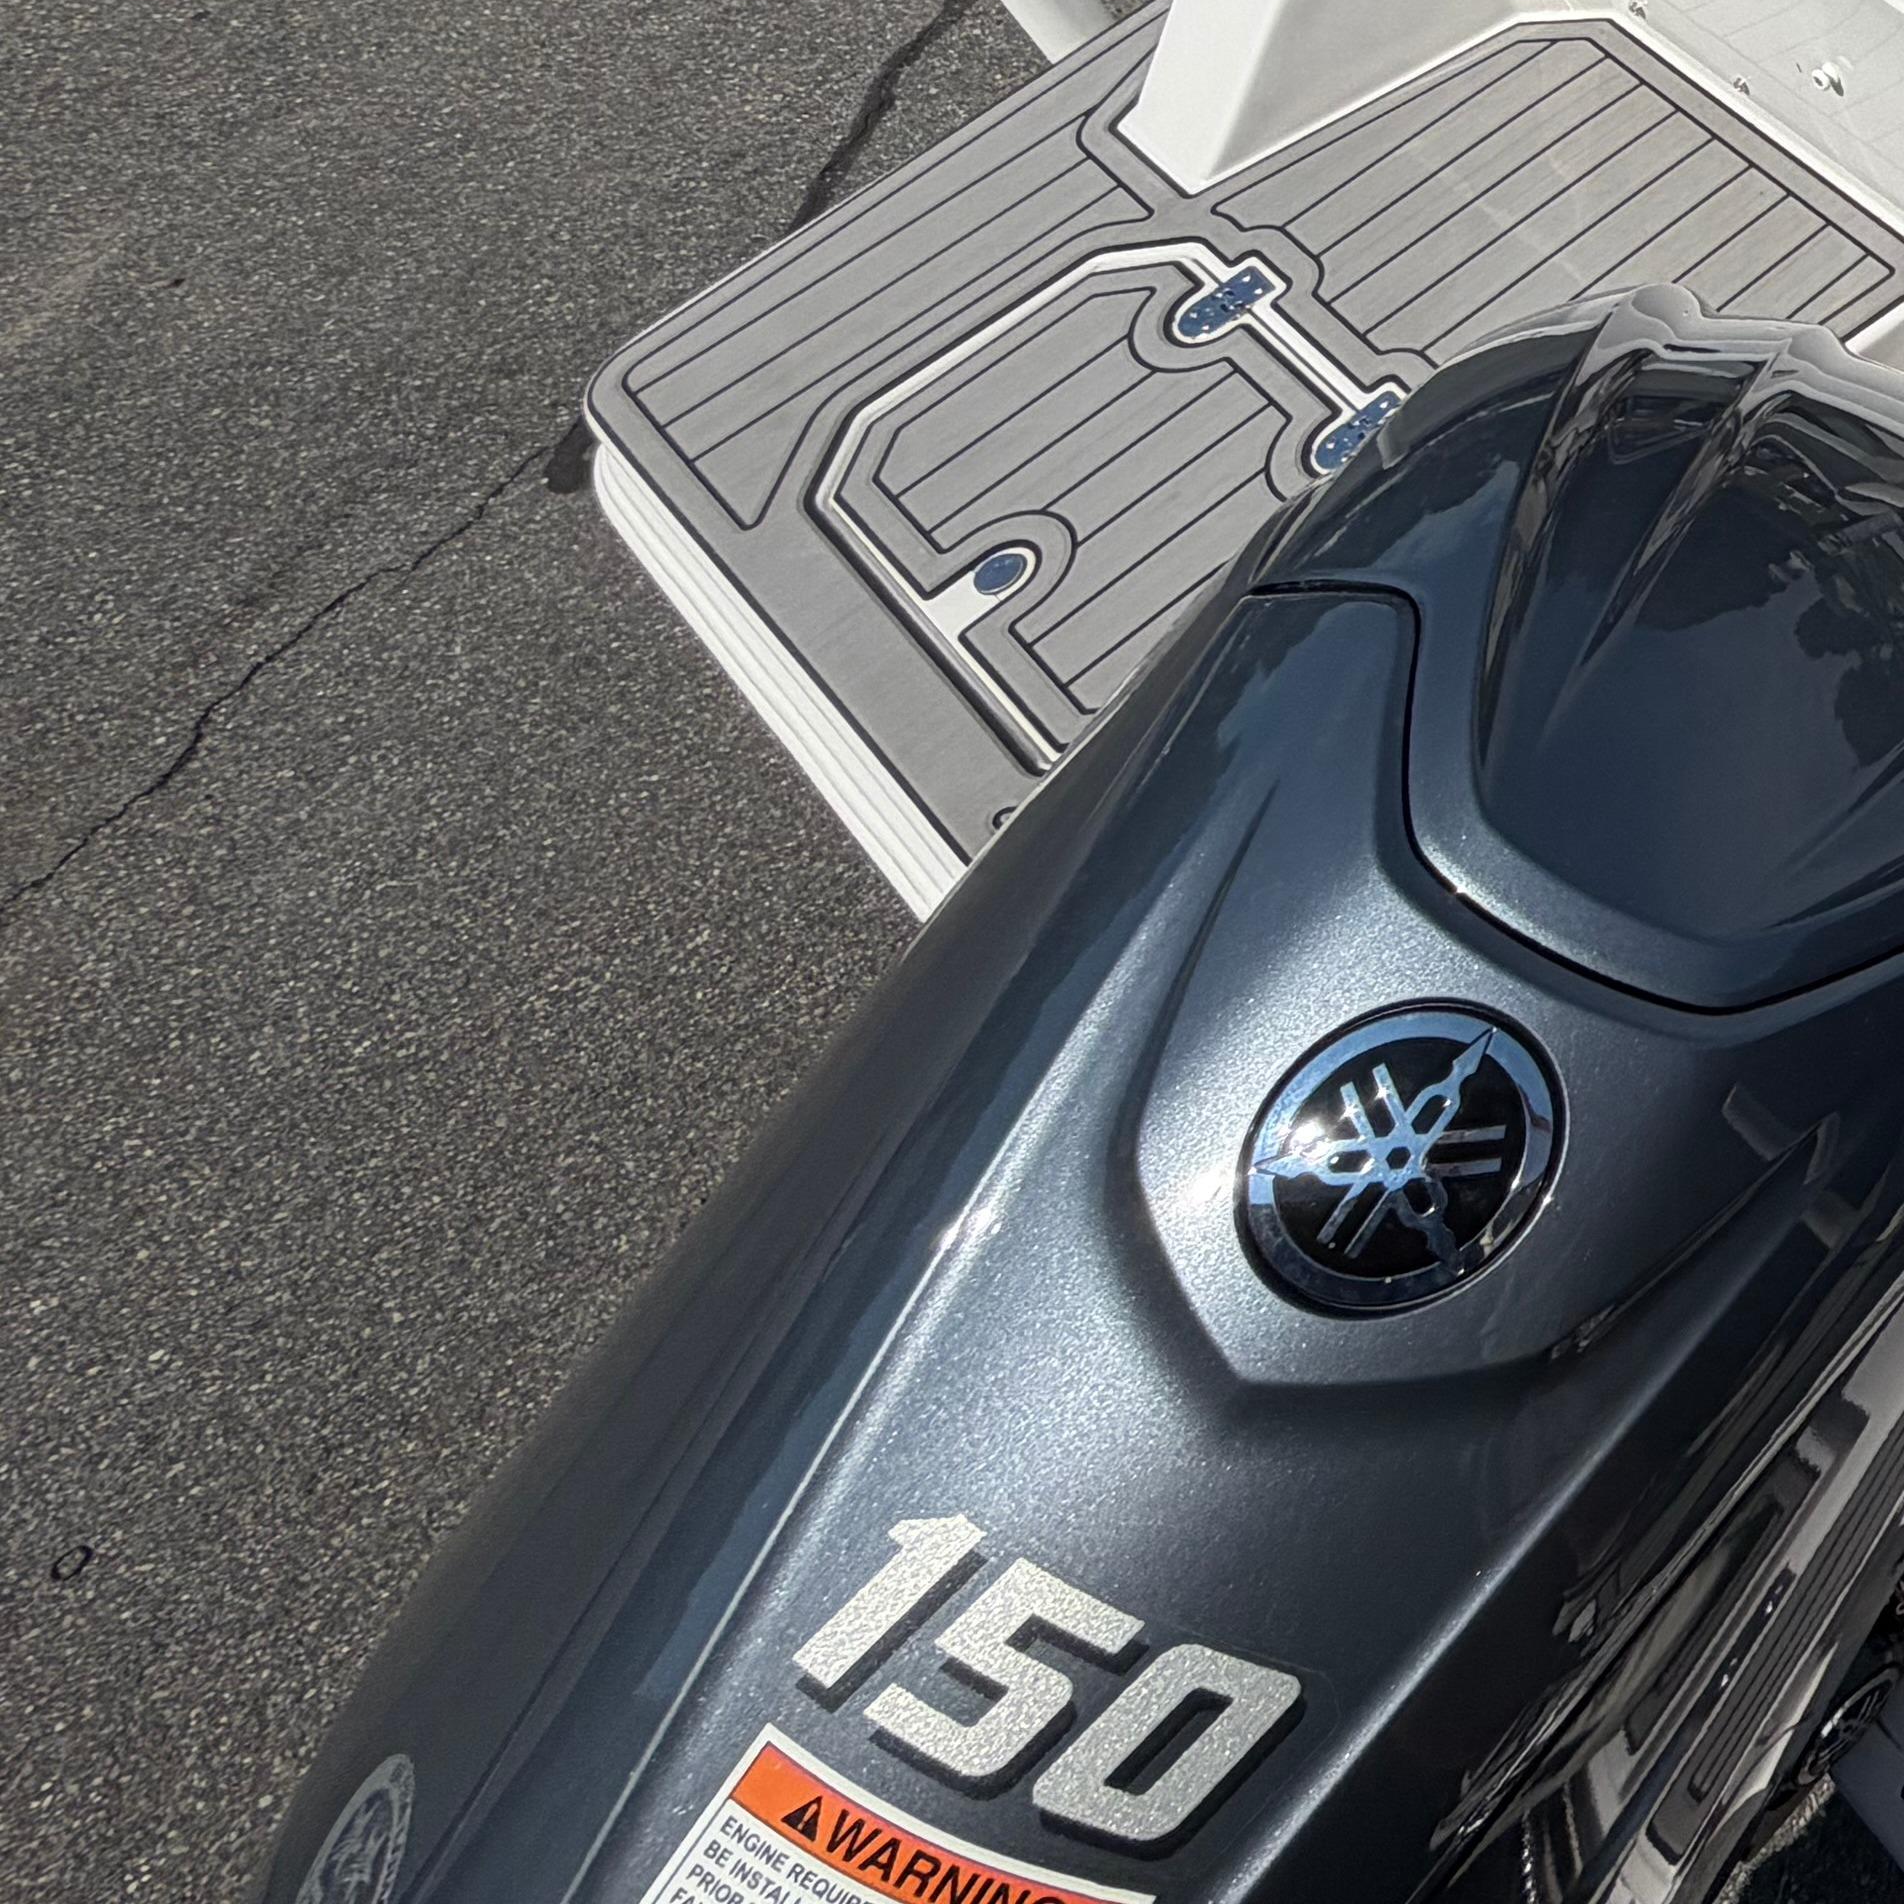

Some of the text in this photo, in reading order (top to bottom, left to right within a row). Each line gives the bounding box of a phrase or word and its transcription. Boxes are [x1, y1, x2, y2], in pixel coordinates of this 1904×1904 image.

[792, 1513, 1303, 1846] 150
[703, 1839, 734, 1868] BE
[720, 1815, 874, 1904] ENGINE REQUIR
[825, 1807, 1066, 1904] WARNIN
